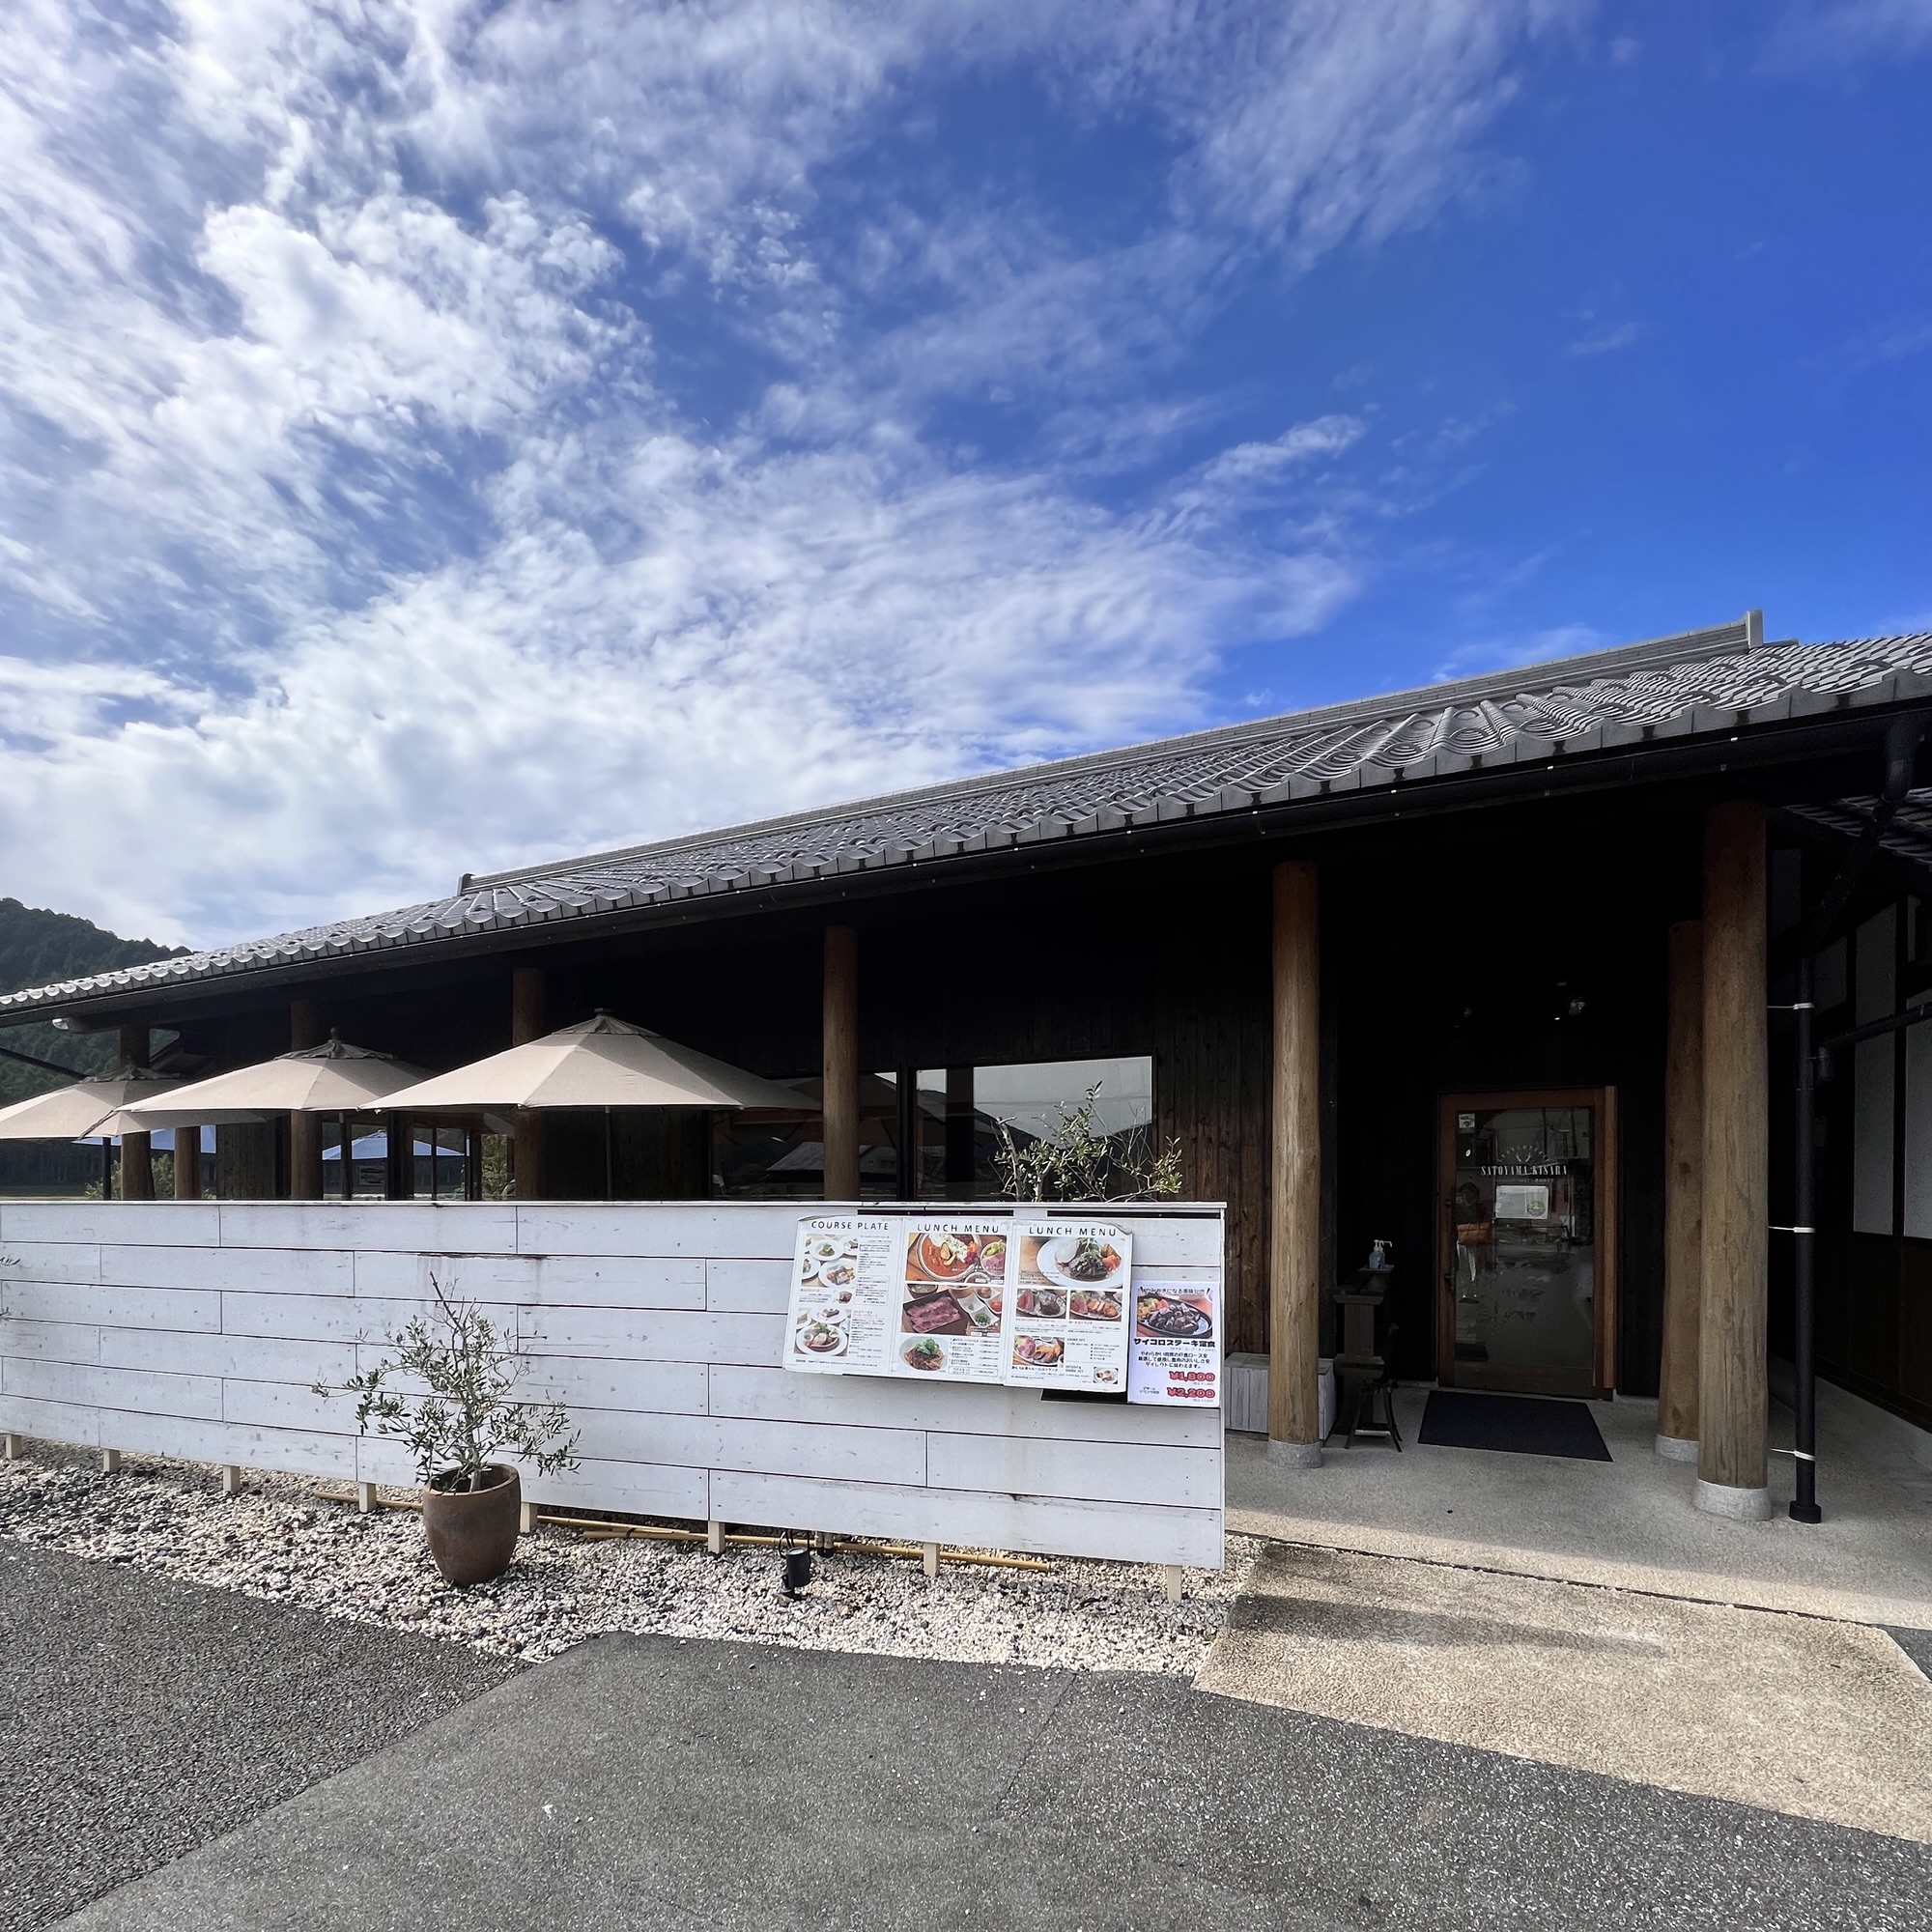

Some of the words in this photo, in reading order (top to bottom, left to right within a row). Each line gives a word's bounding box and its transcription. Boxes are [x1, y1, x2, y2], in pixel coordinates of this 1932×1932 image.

[1079, 1228, 1116, 1236] MENU
[1133, 1338, 1215, 1348] サイコロステーキ定食
[1169, 1371, 1215, 1381] ¥1,800
[1166, 1387, 1215, 1398] ¥2,200
